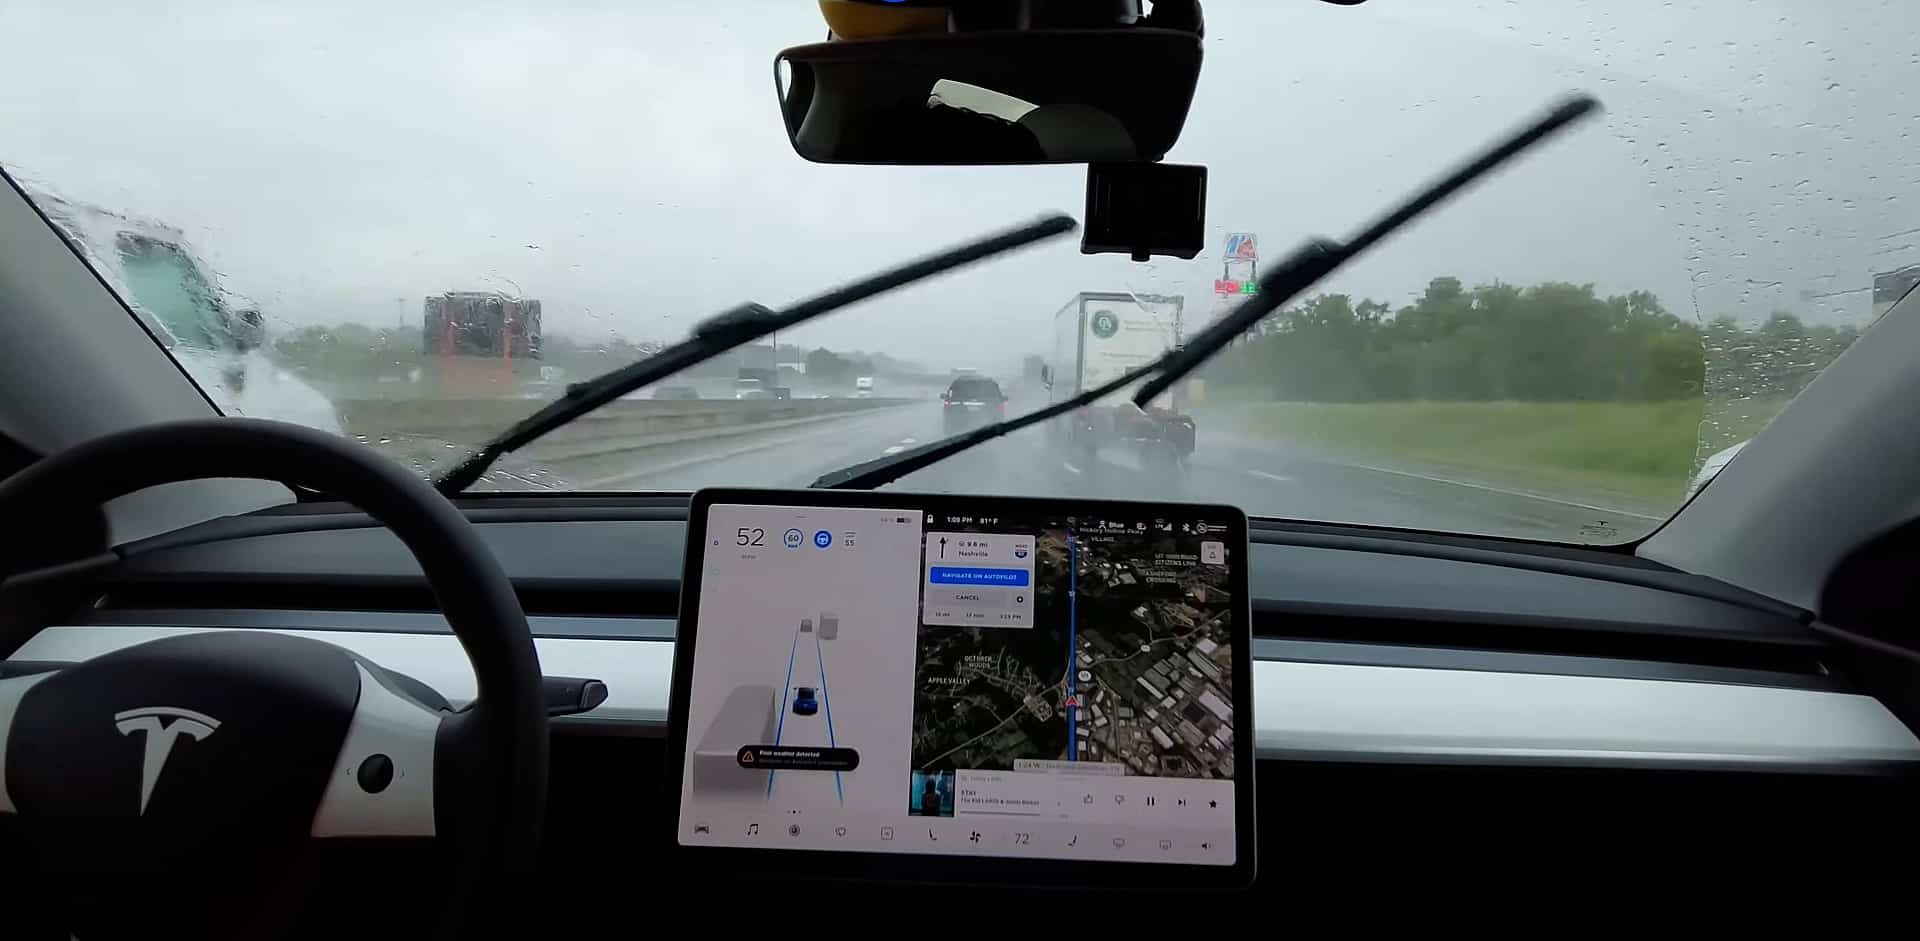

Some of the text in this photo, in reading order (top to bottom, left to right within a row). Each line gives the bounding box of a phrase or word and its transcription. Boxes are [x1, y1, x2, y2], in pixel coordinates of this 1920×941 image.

[736, 528, 764, 546] 52
[788, 534, 799, 542] 60
[1015, 832, 1030, 845] 72
